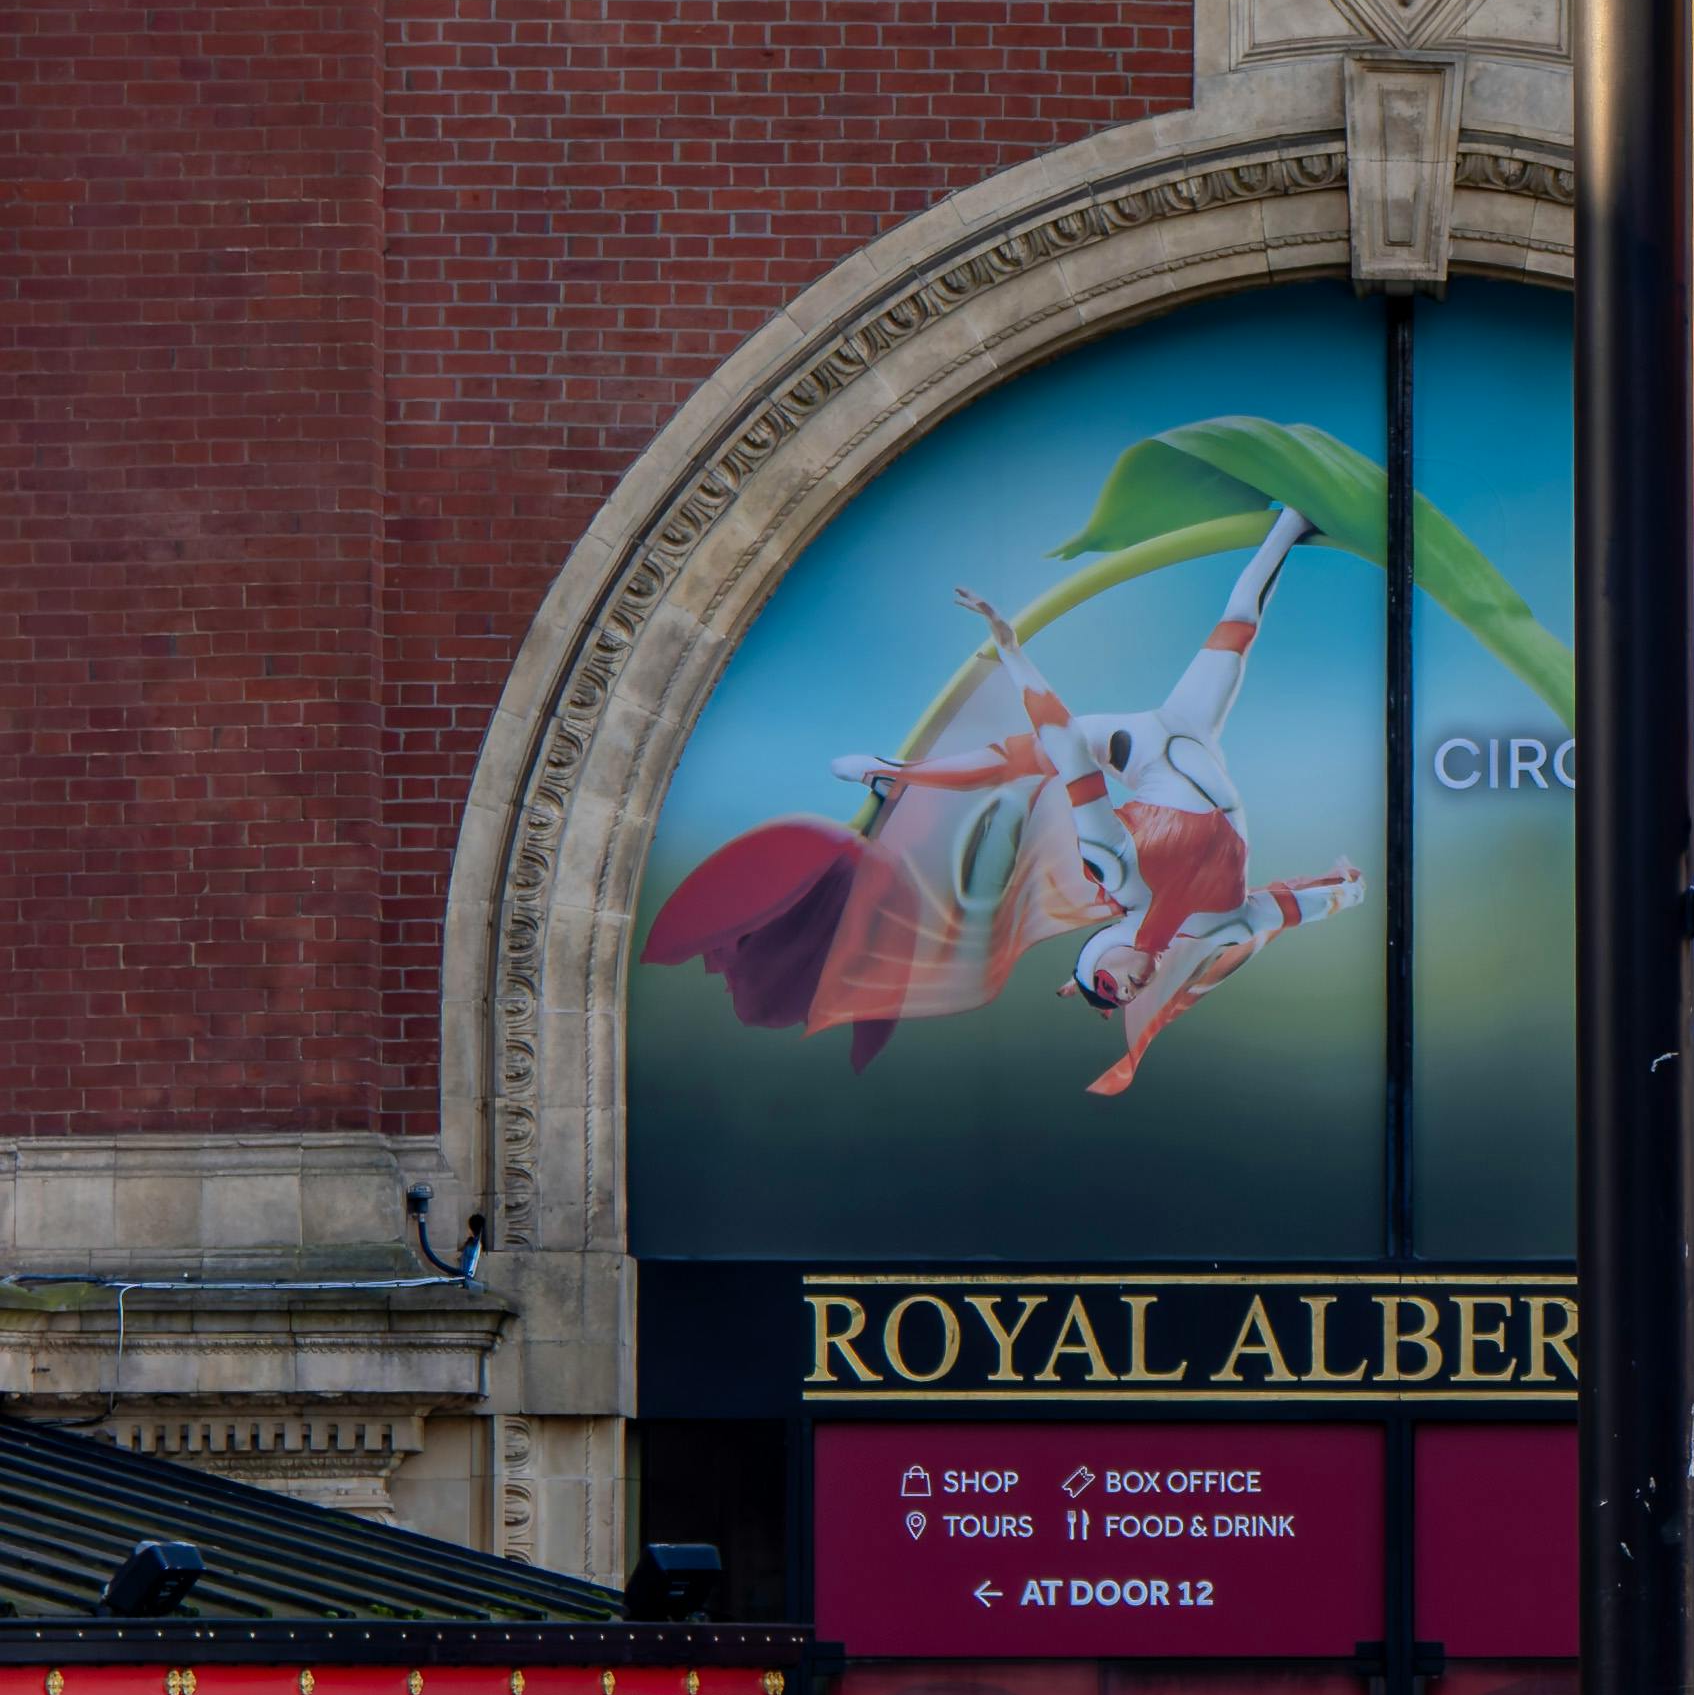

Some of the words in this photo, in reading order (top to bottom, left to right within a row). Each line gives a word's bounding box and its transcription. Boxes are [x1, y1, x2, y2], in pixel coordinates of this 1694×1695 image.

[804, 1294, 1188, 1384] ROYAL
[1210, 1294, 1580, 1384] ALBER
[943, 1470, 1020, 1495] SHOP
[1106, 1470, 1160, 1495] BOX
[1165, 1470, 1261, 1495] OFFICE
[944, 1515, 1034, 1540] TOURS
[1105, 1515, 1183, 1540] FOOD
[1190, 1515, 1208, 1540] &
[1213, 1515, 1296, 1540] DRINK
[1021, 1581, 1065, 1608] AT
[1070, 1581, 1171, 1608] DOOR
[1177, 1581, 1215, 1608] 12
